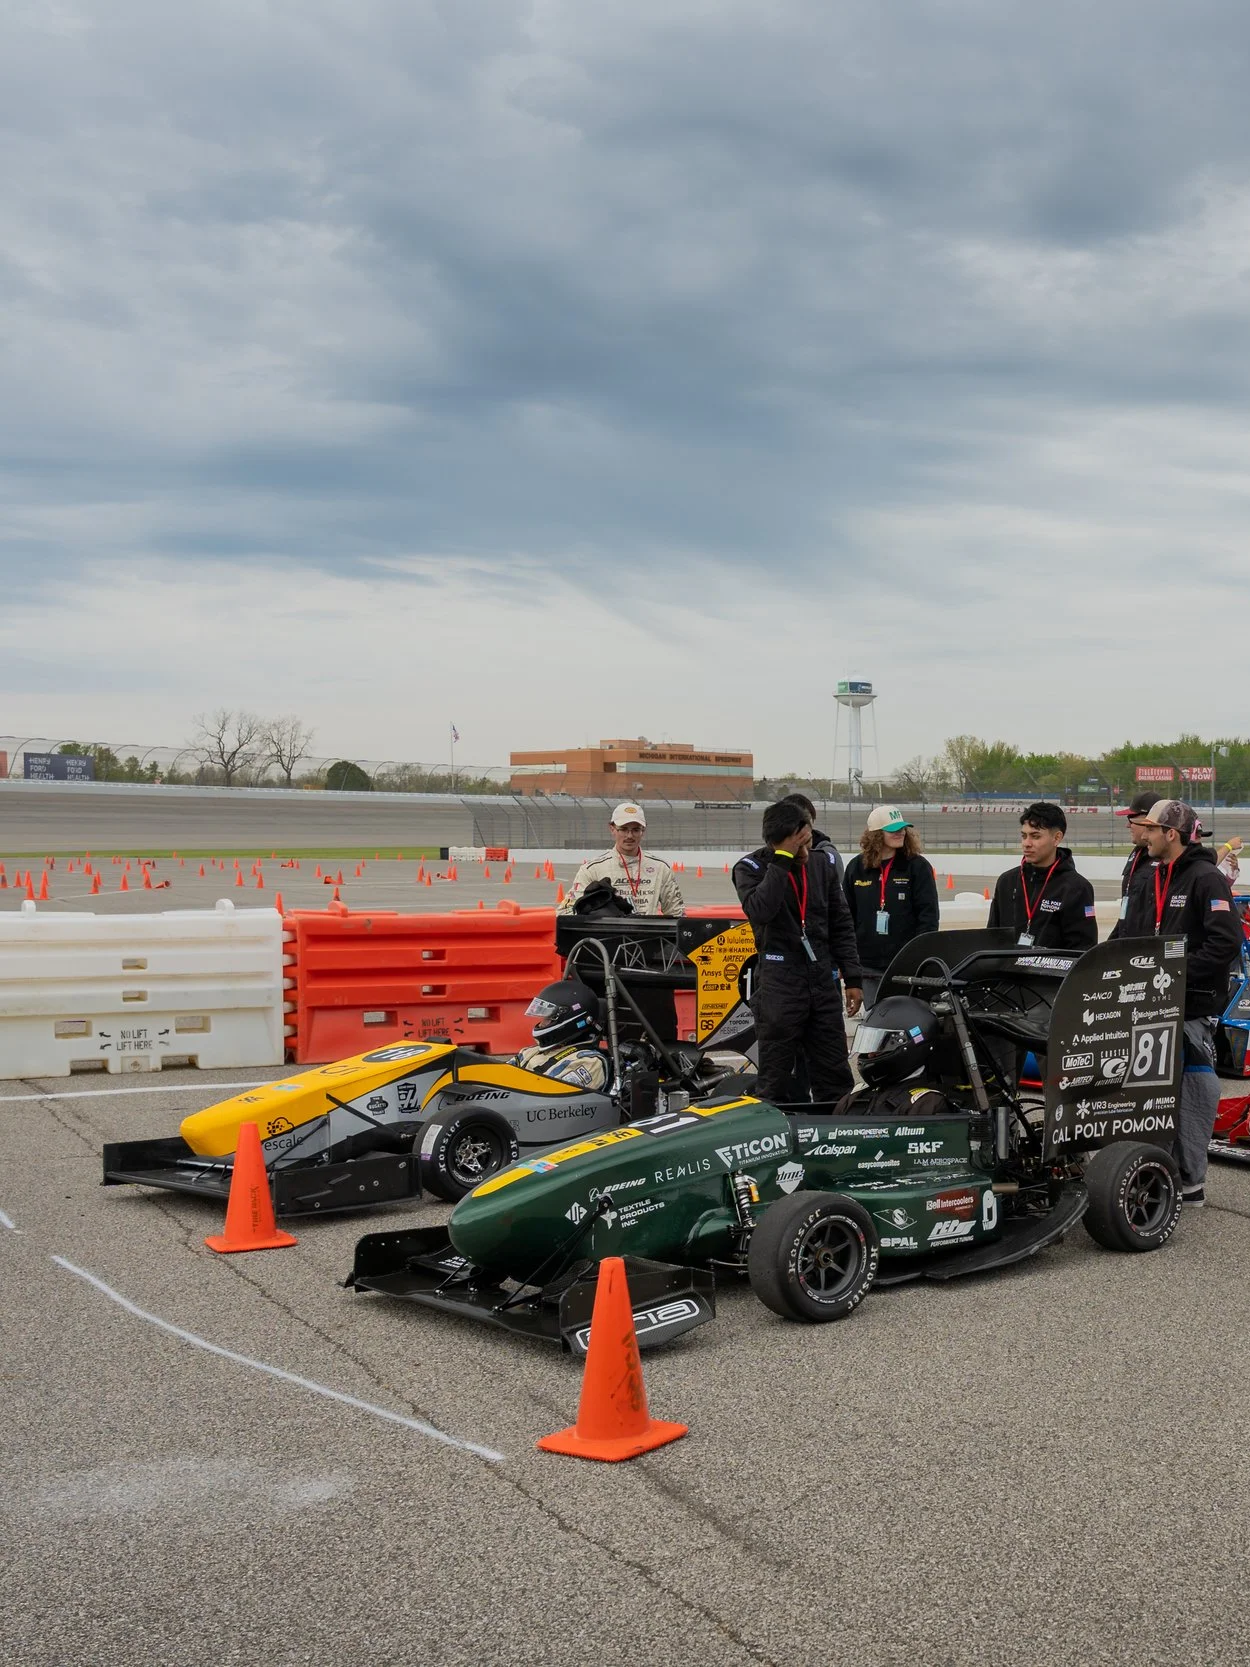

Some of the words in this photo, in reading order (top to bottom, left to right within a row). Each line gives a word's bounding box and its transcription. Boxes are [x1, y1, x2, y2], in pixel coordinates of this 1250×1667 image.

[701, 969, 722, 978] Ansys
[1102, 969, 1123, 980] HPS
[1082, 991, 1113, 1002] DANCO
[1095, 1010, 1121, 1021] HEXAGON
[421, 1018, 431, 1027] NO
[431, 1017, 445, 1027] LIFT
[700, 1019, 715, 1031] GS
[120, 1029, 132, 1040] NO
[132, 1028, 148, 1039] LIFT
[417, 1028, 432, 1039] LIFT
[433, 1027, 450, 1037] HERE
[1080, 1033, 1104, 1044] Applied
[1104, 1031, 1130, 1040] Intuition
[116, 1041, 132, 1051] LIFT
[134, 1040, 153, 1050] HERE
[1132, 1029, 1170, 1078] 81
[1065, 1055, 1091, 1068] MoTeC
[454, 1091, 511, 1102] BOEING
[1155, 1096, 1176, 1105] MIMO
[1091, 1100, 1107, 1111] VR3
[1107, 1101, 1137, 1109] Engineering
[526, 1108, 547, 1123] UC
[549, 1104, 598, 1122] Berkeley
[894, 1126, 925, 1137] Altium
[1052, 1126, 1072, 1145] CAL
[1074, 1120, 1108, 1140] POLY
[1112, 1115, 1175, 1136] POMONA
[263, 1135, 305, 1152] escale
[731, 1132, 788, 1160] TiCON
[907, 1141, 944, 1154] SKF
[819, 1144, 857, 1157] Calspan
[738, 1156, 761, 1166] TITANIUM
[761, 1148, 789, 1160] INNOVATION
[857, 1159, 900, 1169] easycomposites
[654, 1158, 711, 1184] REALIS
[602, 1177, 647, 1195] BOEING
[617, 1199, 652, 1214] TEXTILE
[926, 1199, 941, 1211] Bell
[940, 1196, 974, 1208] Intercoolers
[619, 1201, 666, 1222] PRODUCTS
[620, 1219, 639, 1229] INC.
[880, 1236, 918, 1248] SPAL
